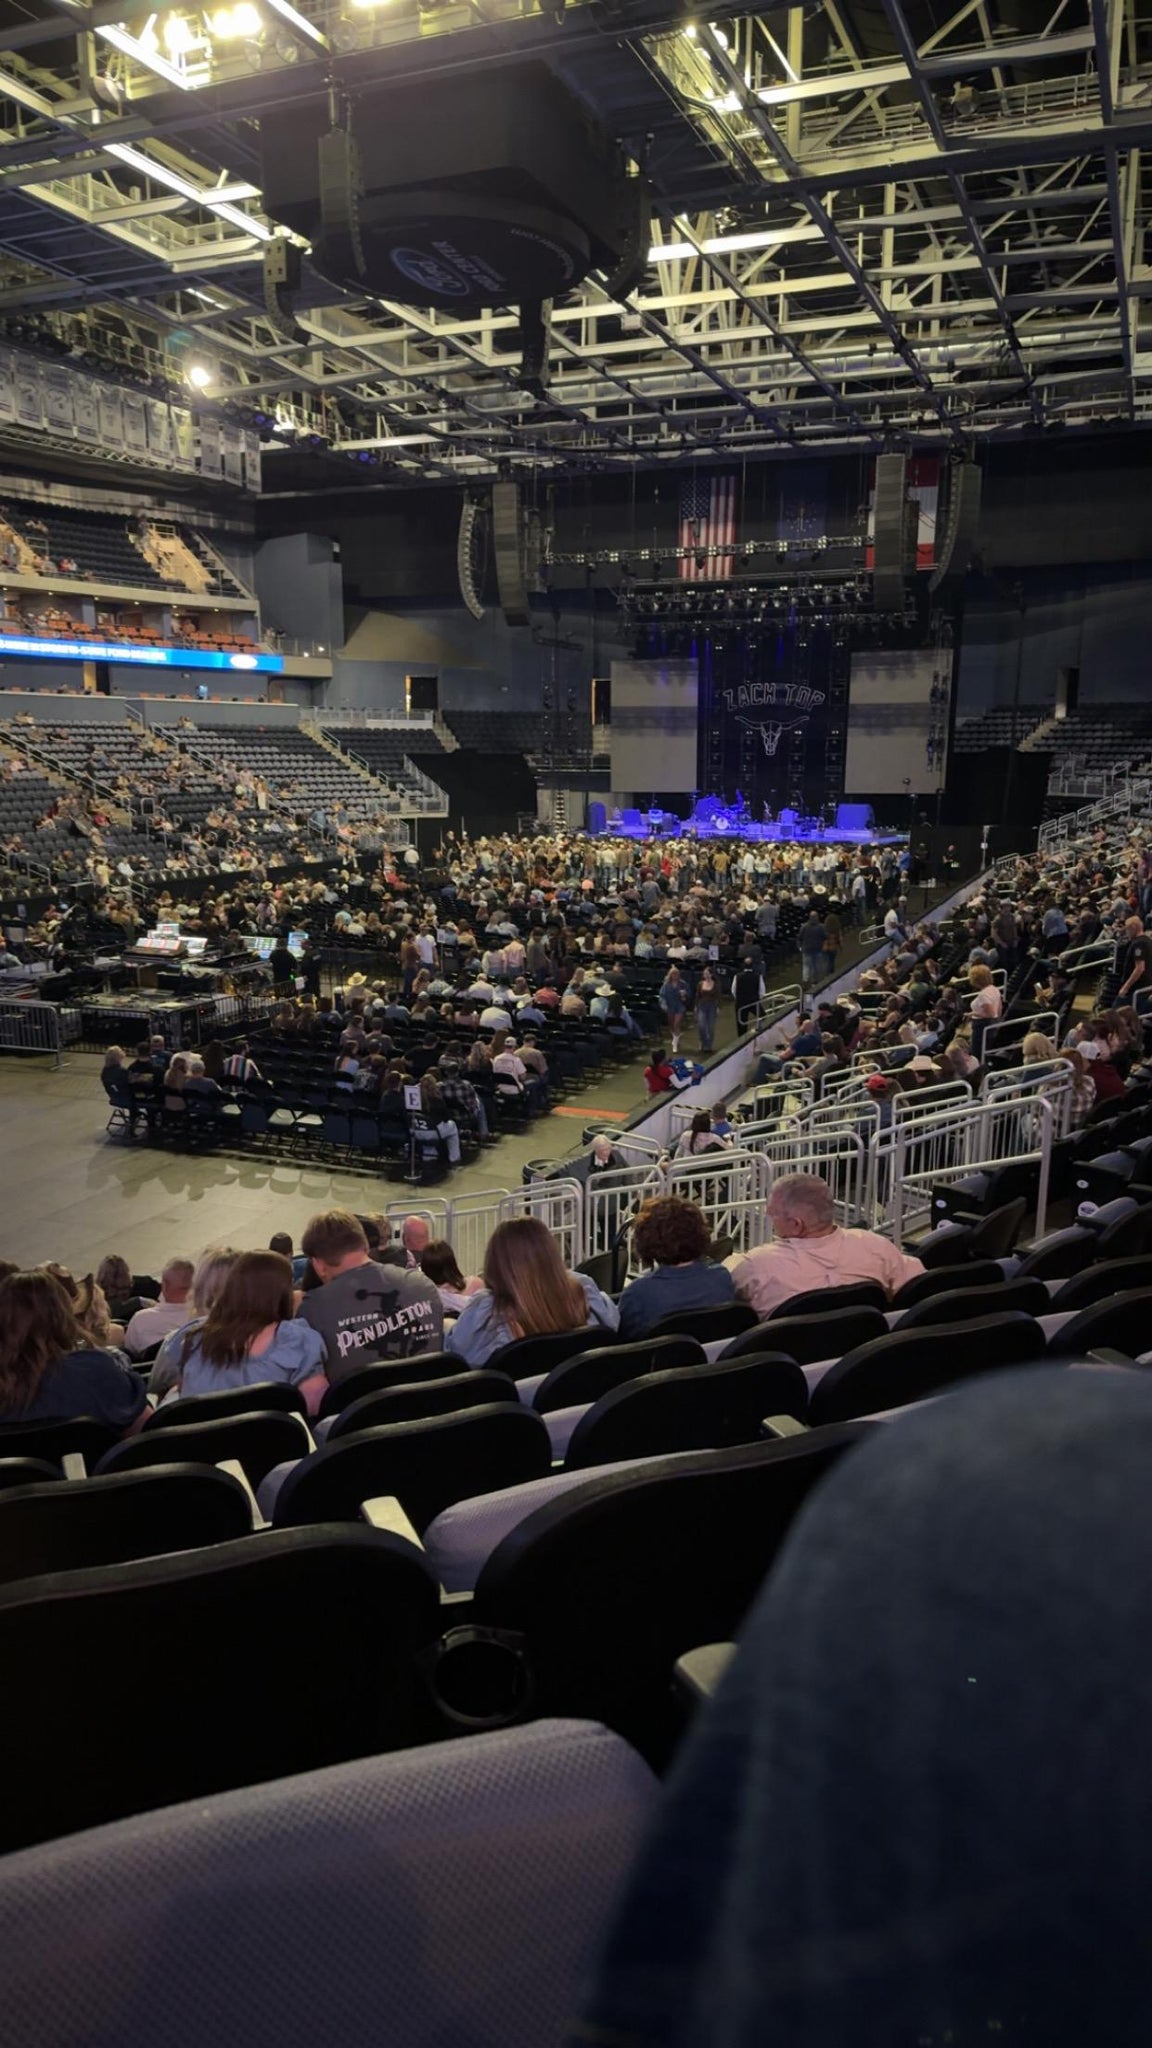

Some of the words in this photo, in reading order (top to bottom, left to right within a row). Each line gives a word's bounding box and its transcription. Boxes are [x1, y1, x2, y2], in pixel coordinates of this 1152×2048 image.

[723, 683, 776, 711] ZACH
[785, 683, 825, 711] TOP
[408, 1092, 419, 1106] E
[336, 1300, 433, 1358] PENDLETON
[338, 1313, 379, 1327] WESTERN
